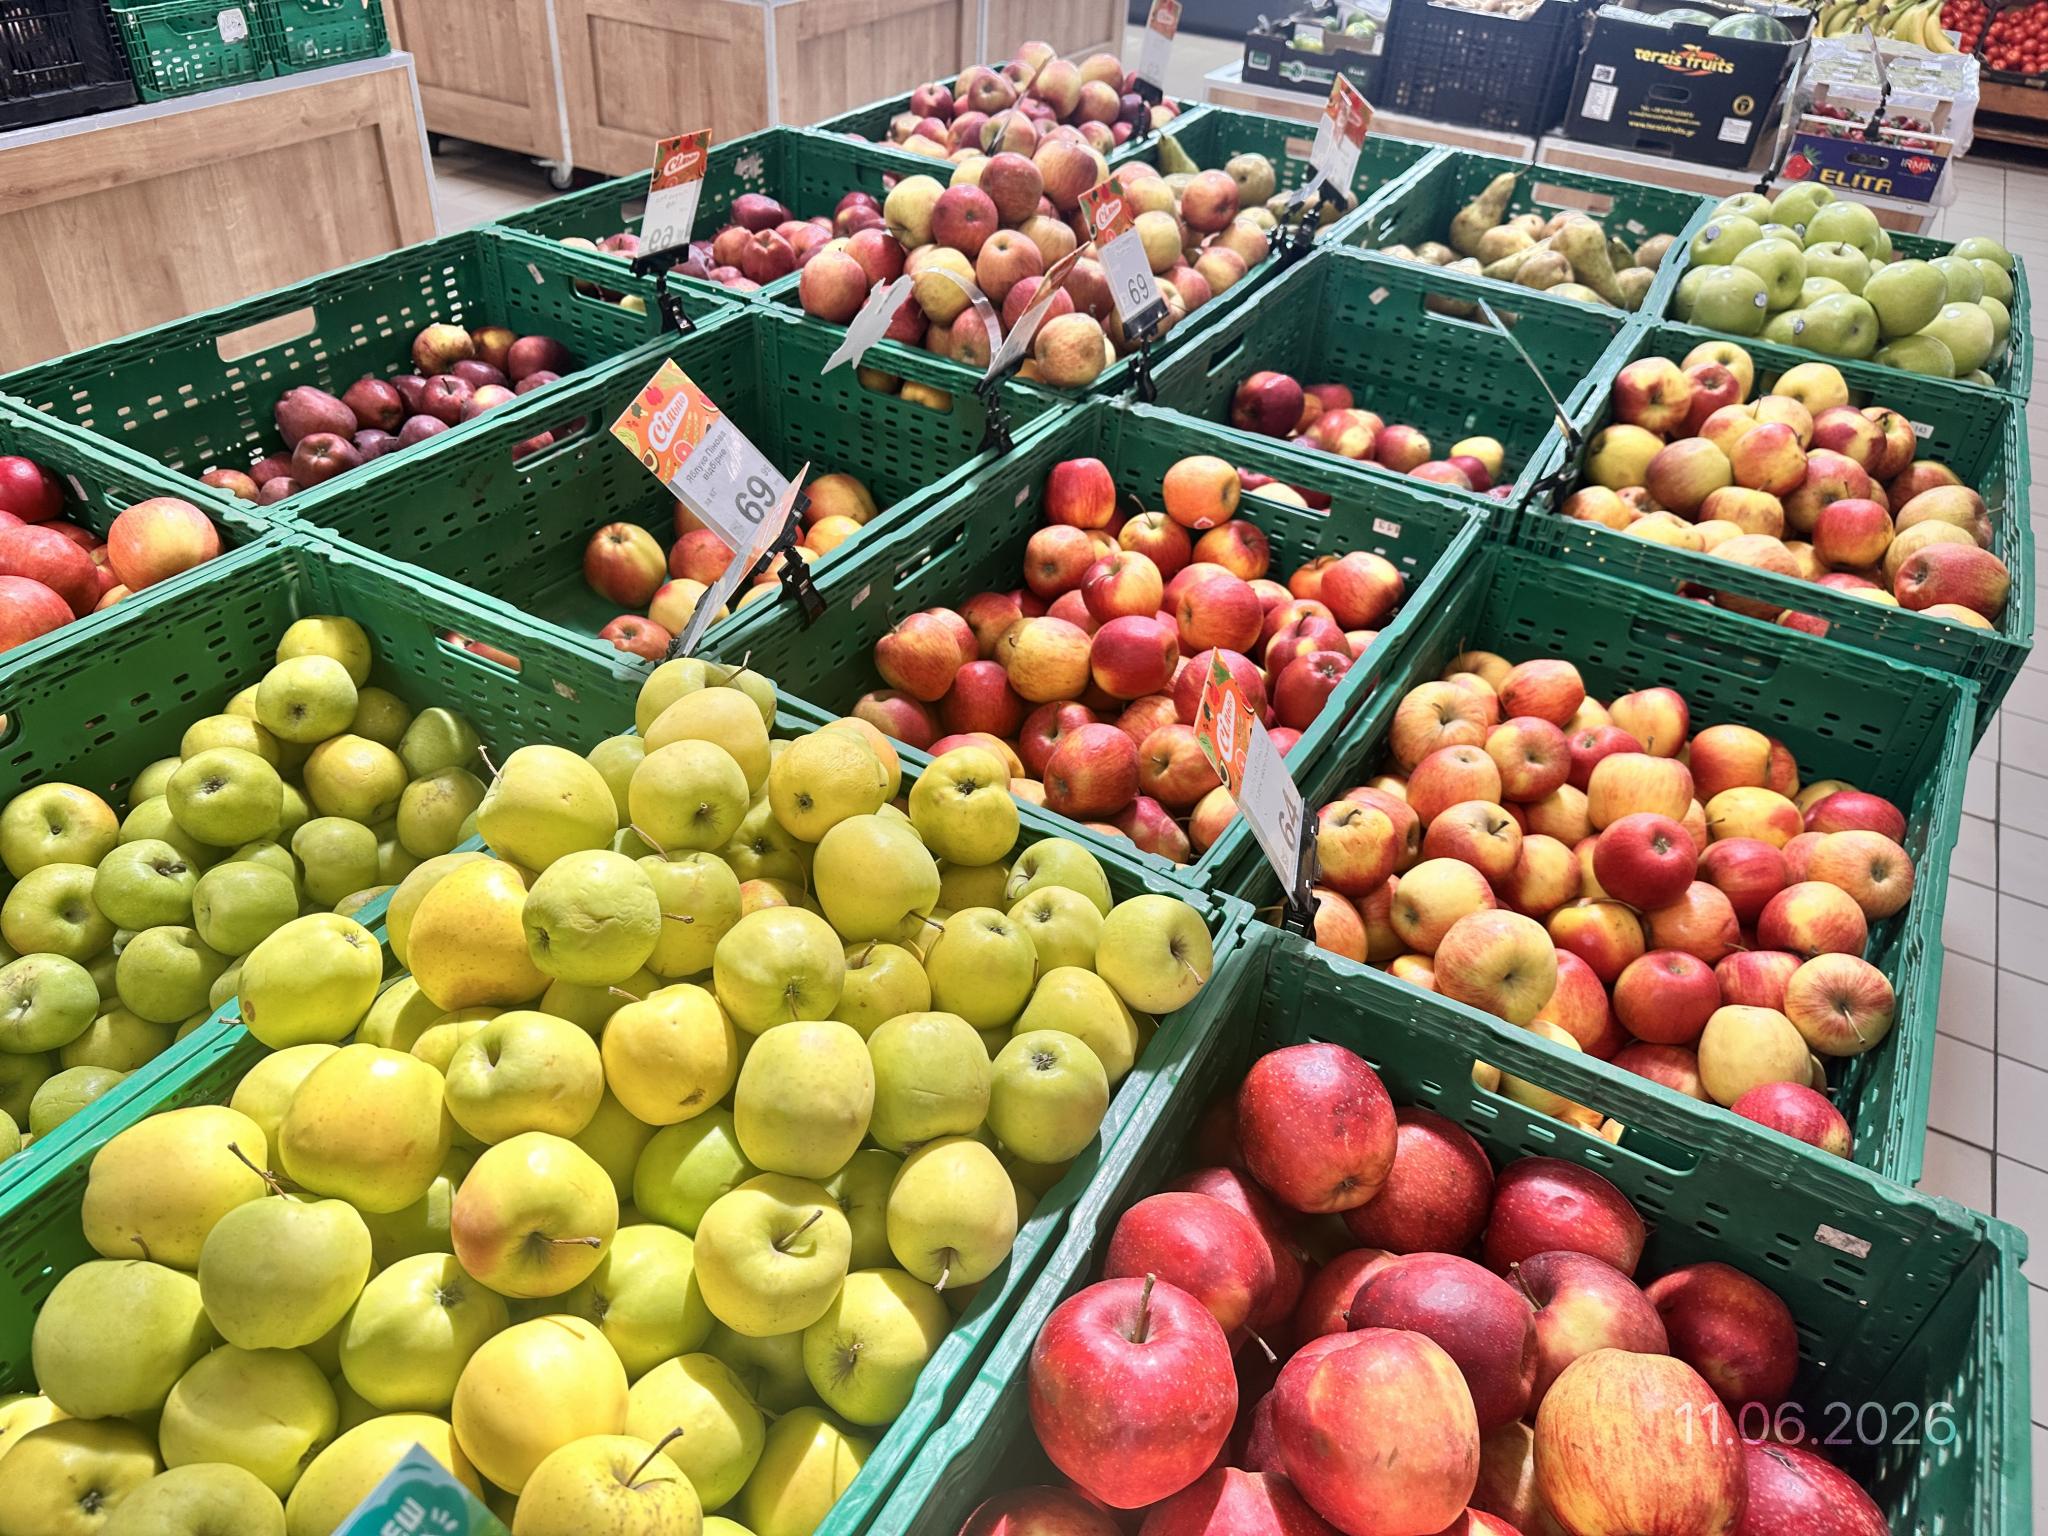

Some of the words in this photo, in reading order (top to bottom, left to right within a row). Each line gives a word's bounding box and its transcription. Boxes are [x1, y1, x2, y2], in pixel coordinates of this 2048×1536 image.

[1634, 47, 1682, 68] terzis
[1685, 52, 1736, 75] fruits
[1819, 168, 1893, 194] ELITA
[1127, 273, 1149, 305] 69
[652, 393, 687, 446] Сільпо
[685, 455, 709, 483] Яблуко
[702, 447, 728, 481] відбірне
[735, 475, 776, 525] 69
[1278, 788, 1300, 853] 64
